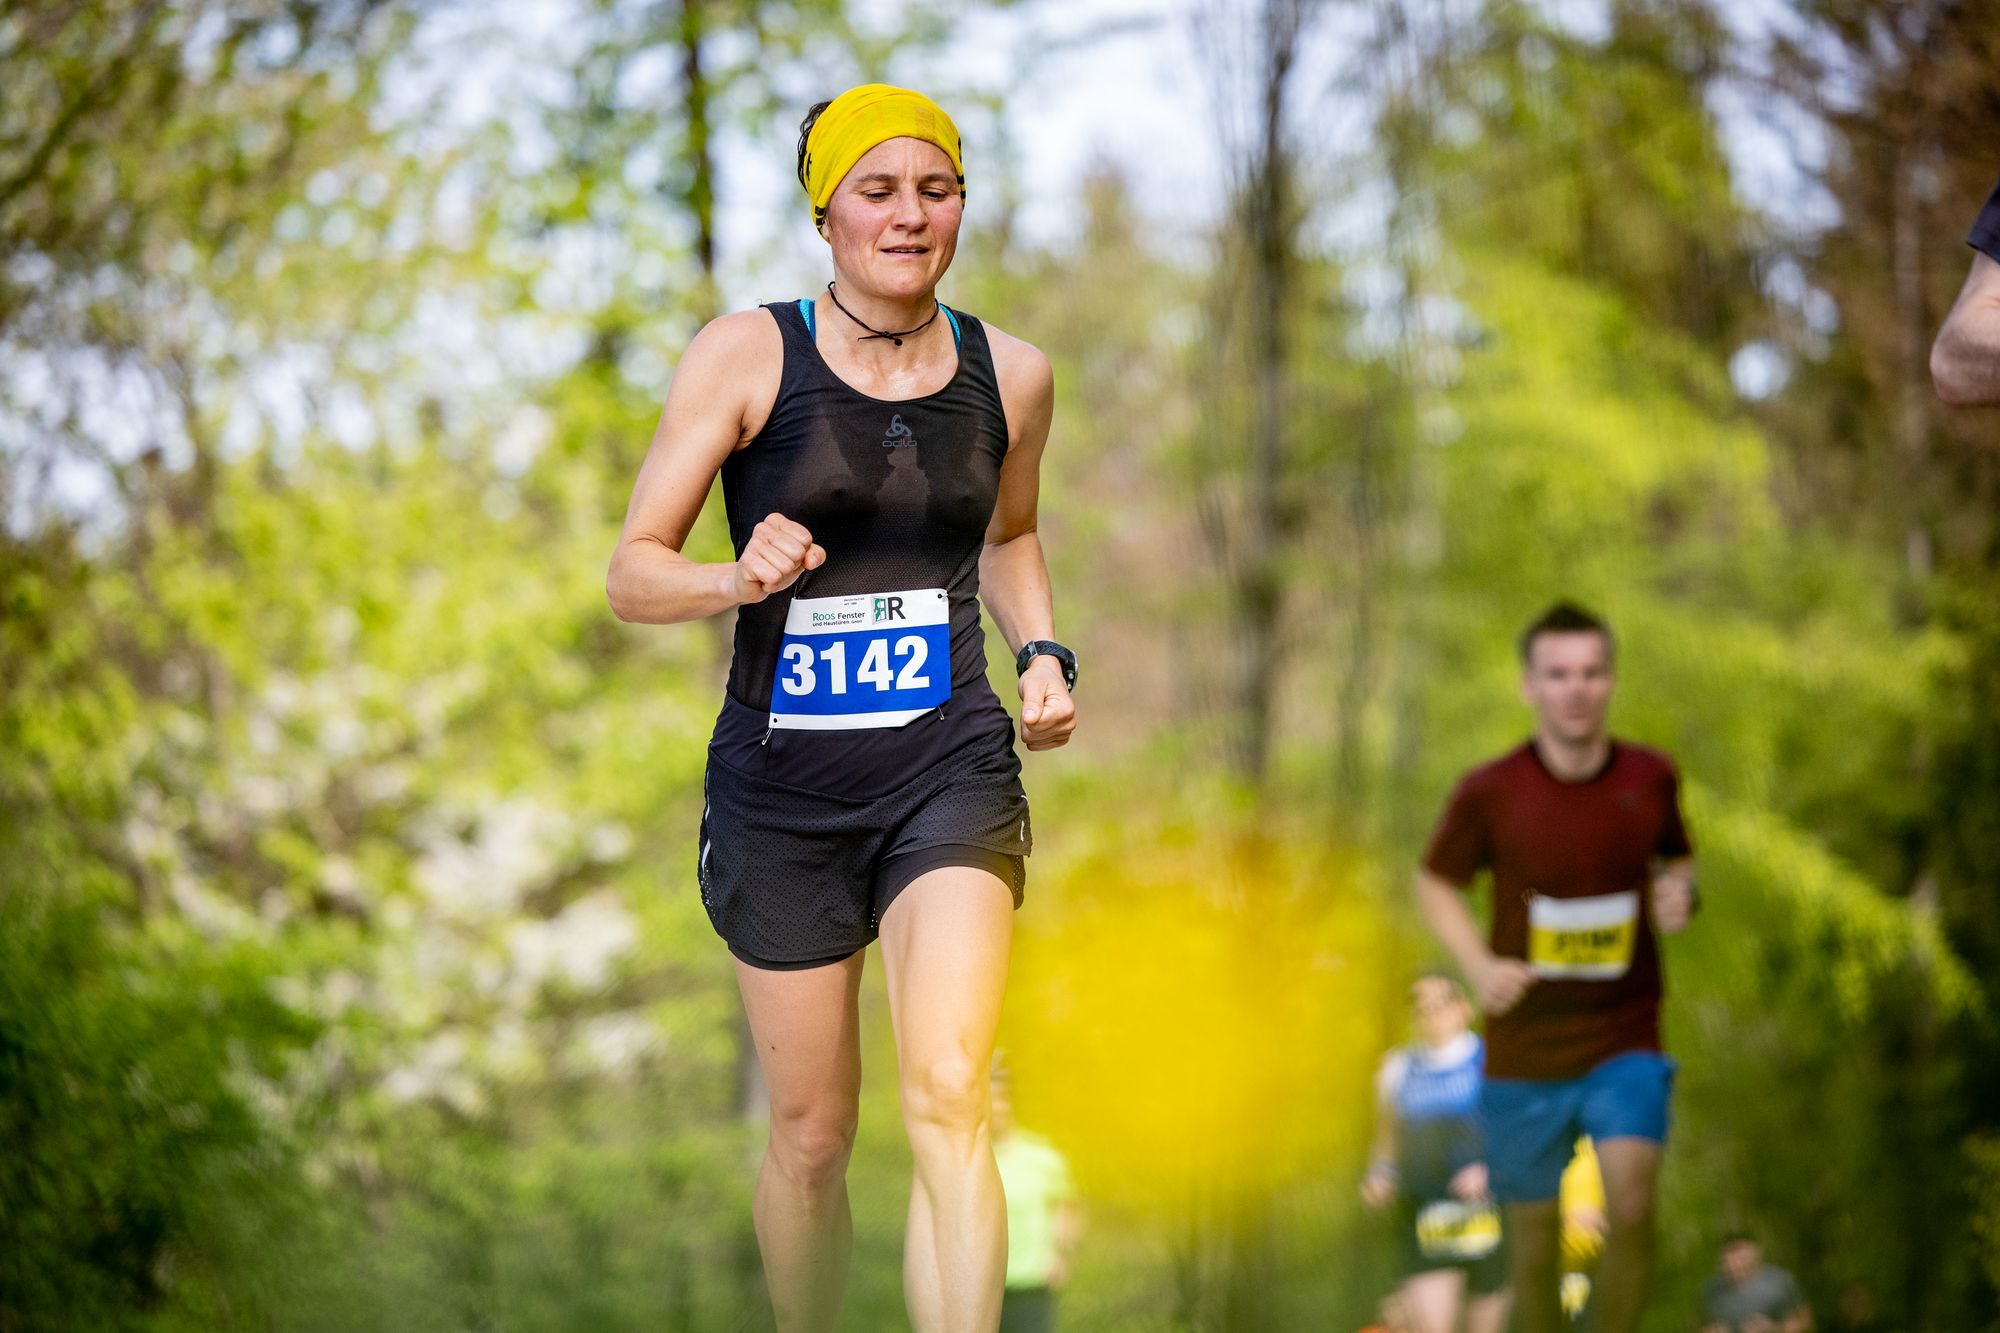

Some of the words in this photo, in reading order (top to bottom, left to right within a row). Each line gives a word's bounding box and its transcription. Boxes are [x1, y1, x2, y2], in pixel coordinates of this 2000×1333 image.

[882, 438, 917, 447] odlo
[837, 611, 866, 620] Fenster
[781, 635, 930, 696] 3142
